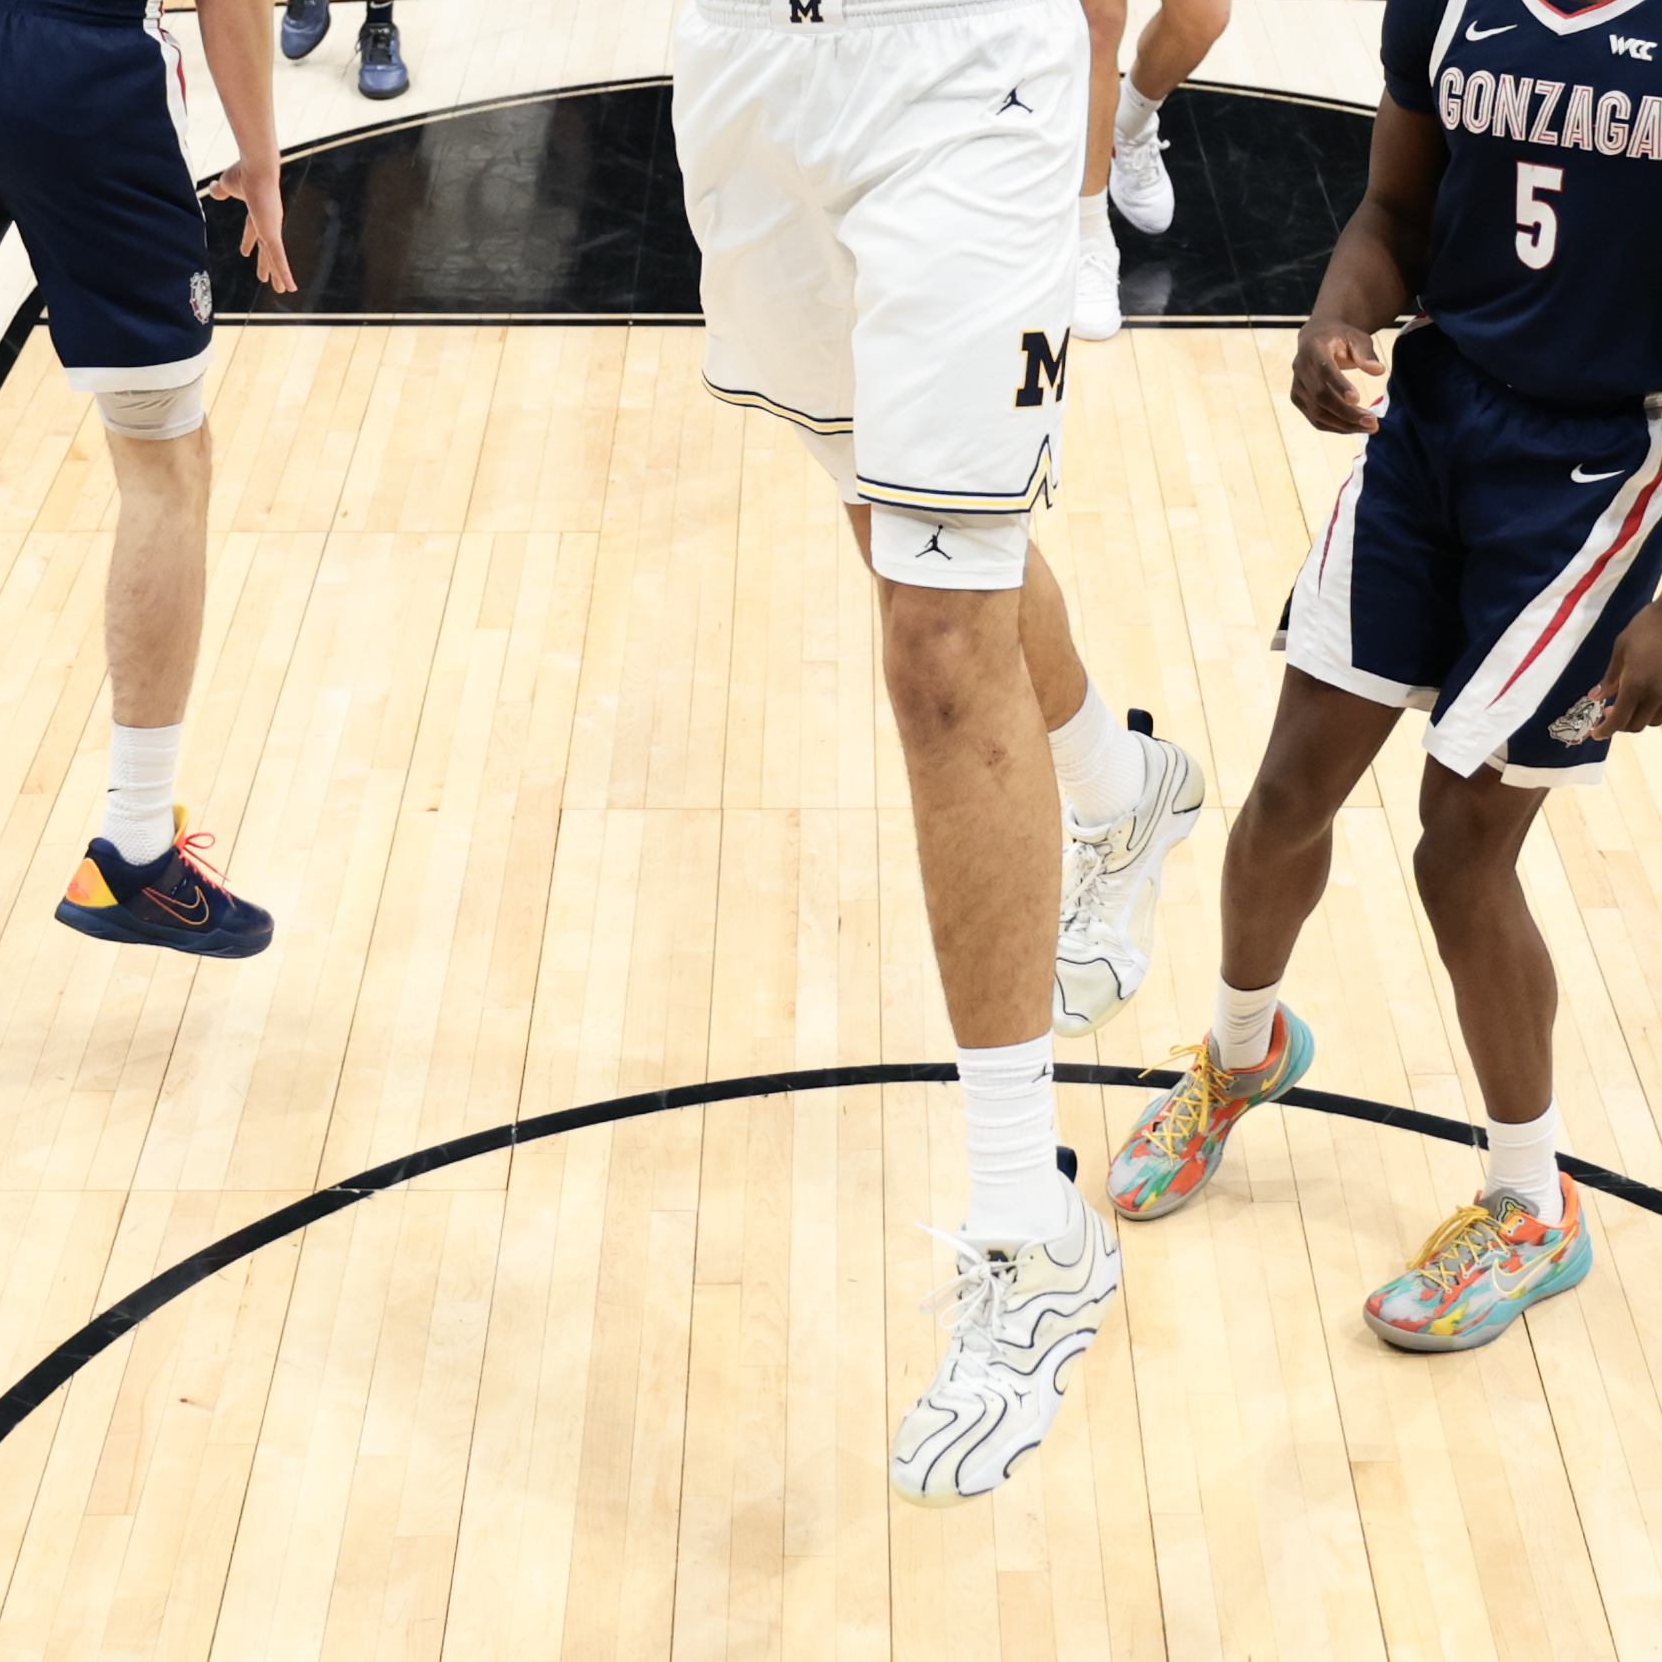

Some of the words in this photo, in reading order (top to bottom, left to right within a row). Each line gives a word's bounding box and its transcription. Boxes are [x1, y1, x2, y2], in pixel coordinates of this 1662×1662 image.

[1608, 34, 1659, 62] WCC
[1515, 160, 1565, 270] 5
[1014, 327, 1070, 409] M
